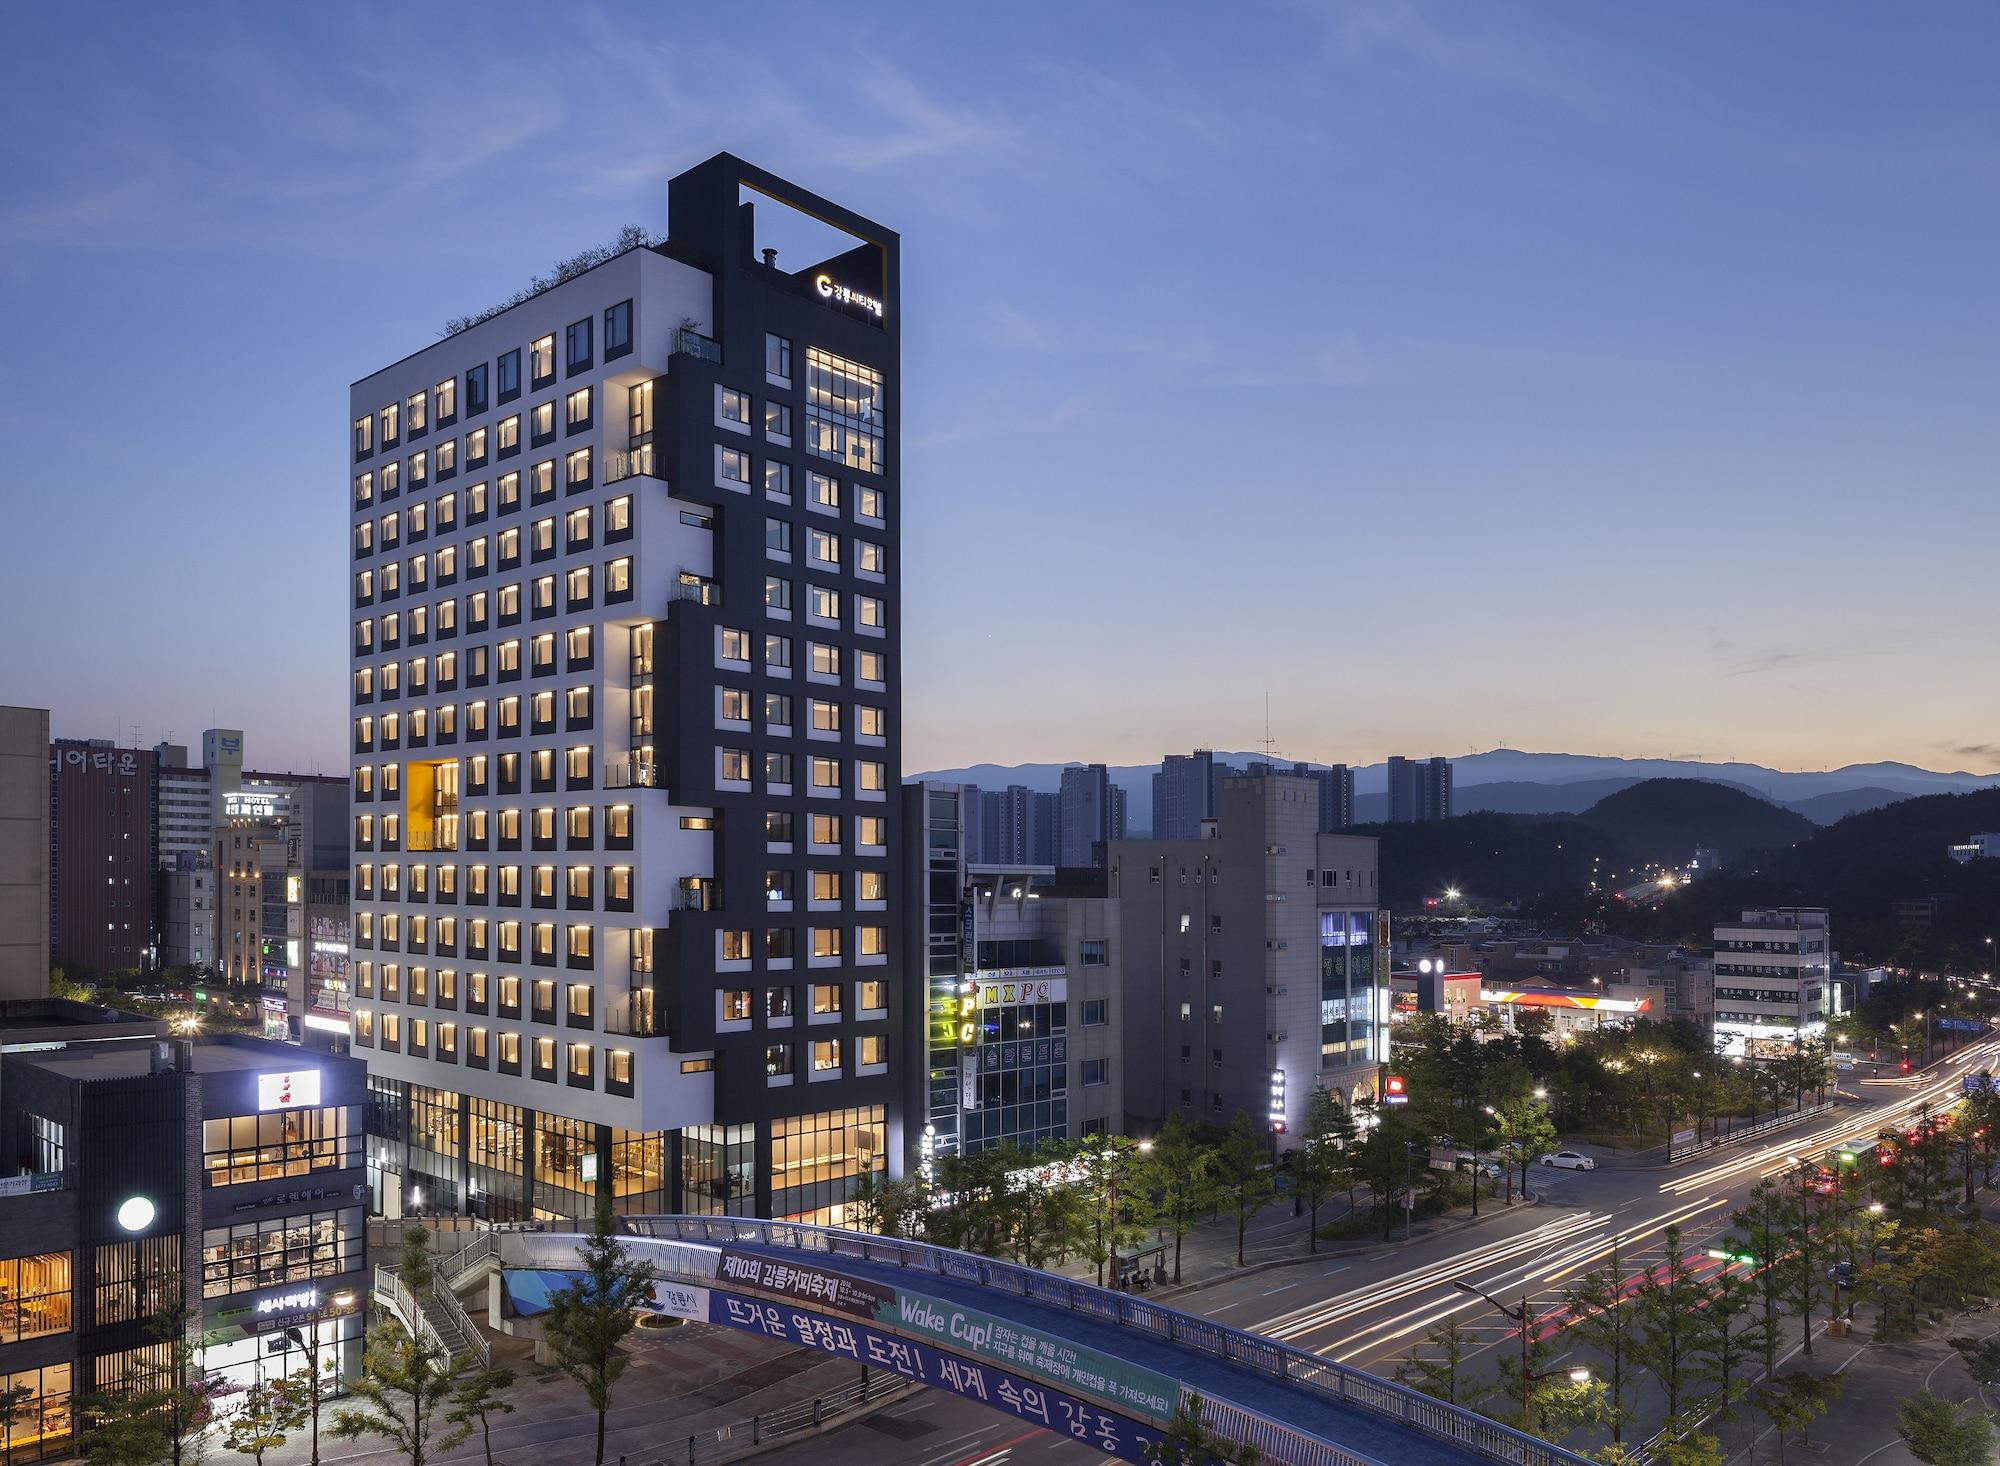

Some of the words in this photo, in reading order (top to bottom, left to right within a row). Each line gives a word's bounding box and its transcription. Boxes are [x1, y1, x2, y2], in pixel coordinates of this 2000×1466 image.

[244, 796, 270, 805] HOTEL
[666, 1290, 698, 1308] 강릉시
[723, 1255, 762, 1283] 제10회
[764, 1264, 839, 1302] 강릉커피축제
[901, 1295, 945, 1333] Wake
[950, 1313, 993, 1351] Cup!
[995, 1326, 1019, 1344] 잠자는
[1021, 1332, 1037, 1350] 컵을
[1039, 1338, 1056, 1356] 깨울
[1057, 1346, 1077, 1365] 시간!
[726, 1298, 787, 1338] 뜨거운
[791, 1313, 858, 1358] 열정과
[866, 1334, 926, 1379] 도전!
[940, 1358, 988, 1401] 세계
[997, 1378, 1050, 1425] 속의
[1059, 1400, 1121, 1451] 감동
[993, 1341, 1015, 1360] 지구를
[1018, 1348, 1034, 1366] 위해
[1036, 1354, 1070, 1379] 축제장에
[1072, 1366, 1106, 1392] 개인컵을
[1108, 1379, 1118, 1396] 꼭
[1120, 1386, 1169, 1414] 가져오세요!
